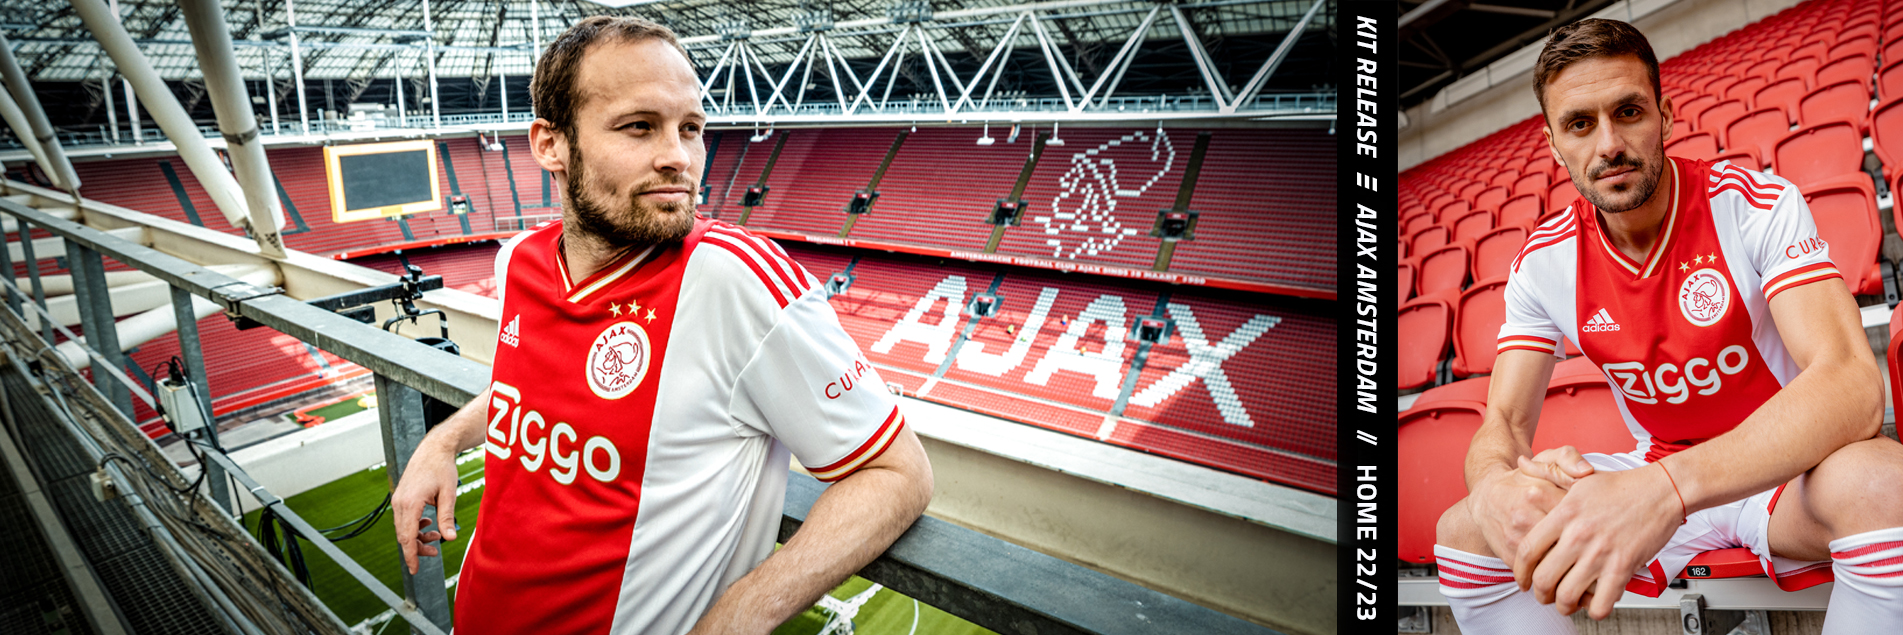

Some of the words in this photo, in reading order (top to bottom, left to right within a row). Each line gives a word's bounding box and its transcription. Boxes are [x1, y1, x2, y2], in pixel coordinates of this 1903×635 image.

[1014, 258, 1054, 268] FOOTBALL
[1055, 262, 1077, 271] CLUB
[1078, 264, 1101, 273] AJAX
[1681, 274, 1700, 301] AJAX
[1582, 323, 1621, 333] adidas
[500, 332, 519, 348] adidas
[596, 326, 627, 352] AJAX
[870, 275, 1282, 428] AJAX
[1691, 567, 1707, 576] 162
